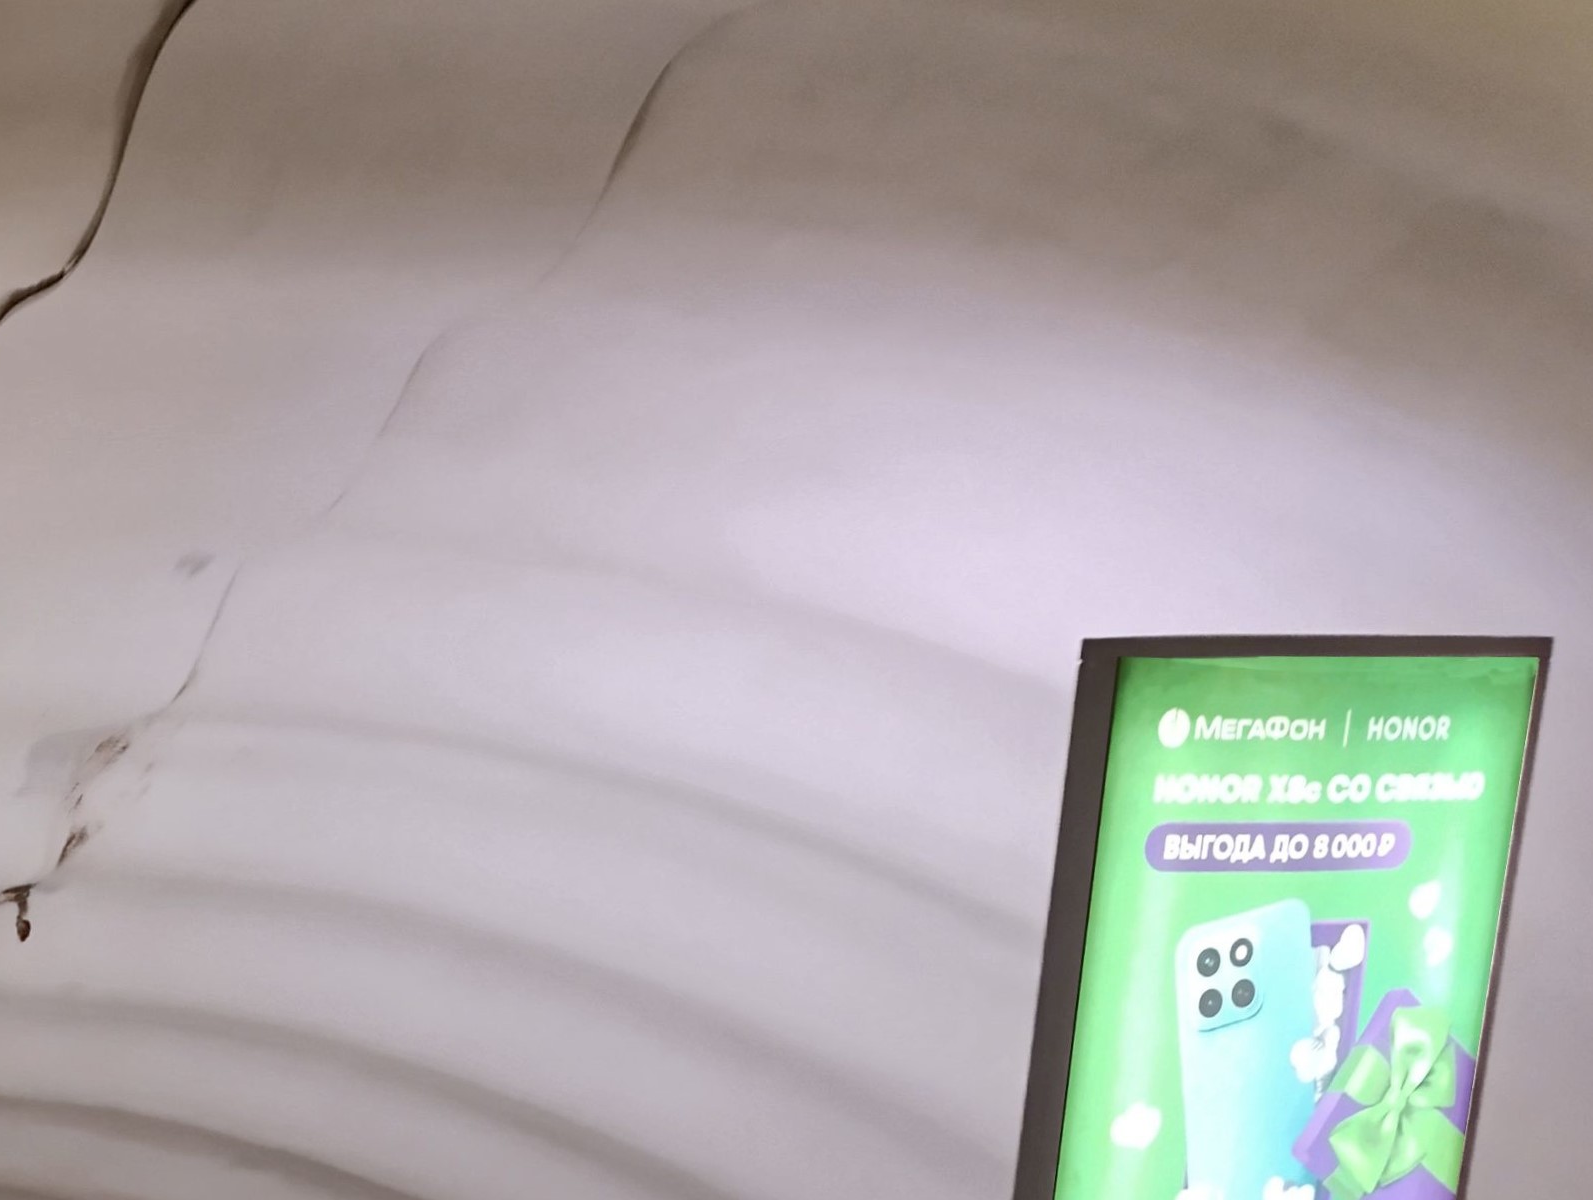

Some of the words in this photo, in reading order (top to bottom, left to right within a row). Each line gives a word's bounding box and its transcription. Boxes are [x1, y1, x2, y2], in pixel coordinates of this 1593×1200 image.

[1367, 715, 1451, 741] HONOR
[1153, 772, 1263, 804] HONOR
[1326, 772, 1372, 804] СО
[1163, 834, 1266, 864] ВЫГОДА
[1269, 833, 1309, 864] ДО
